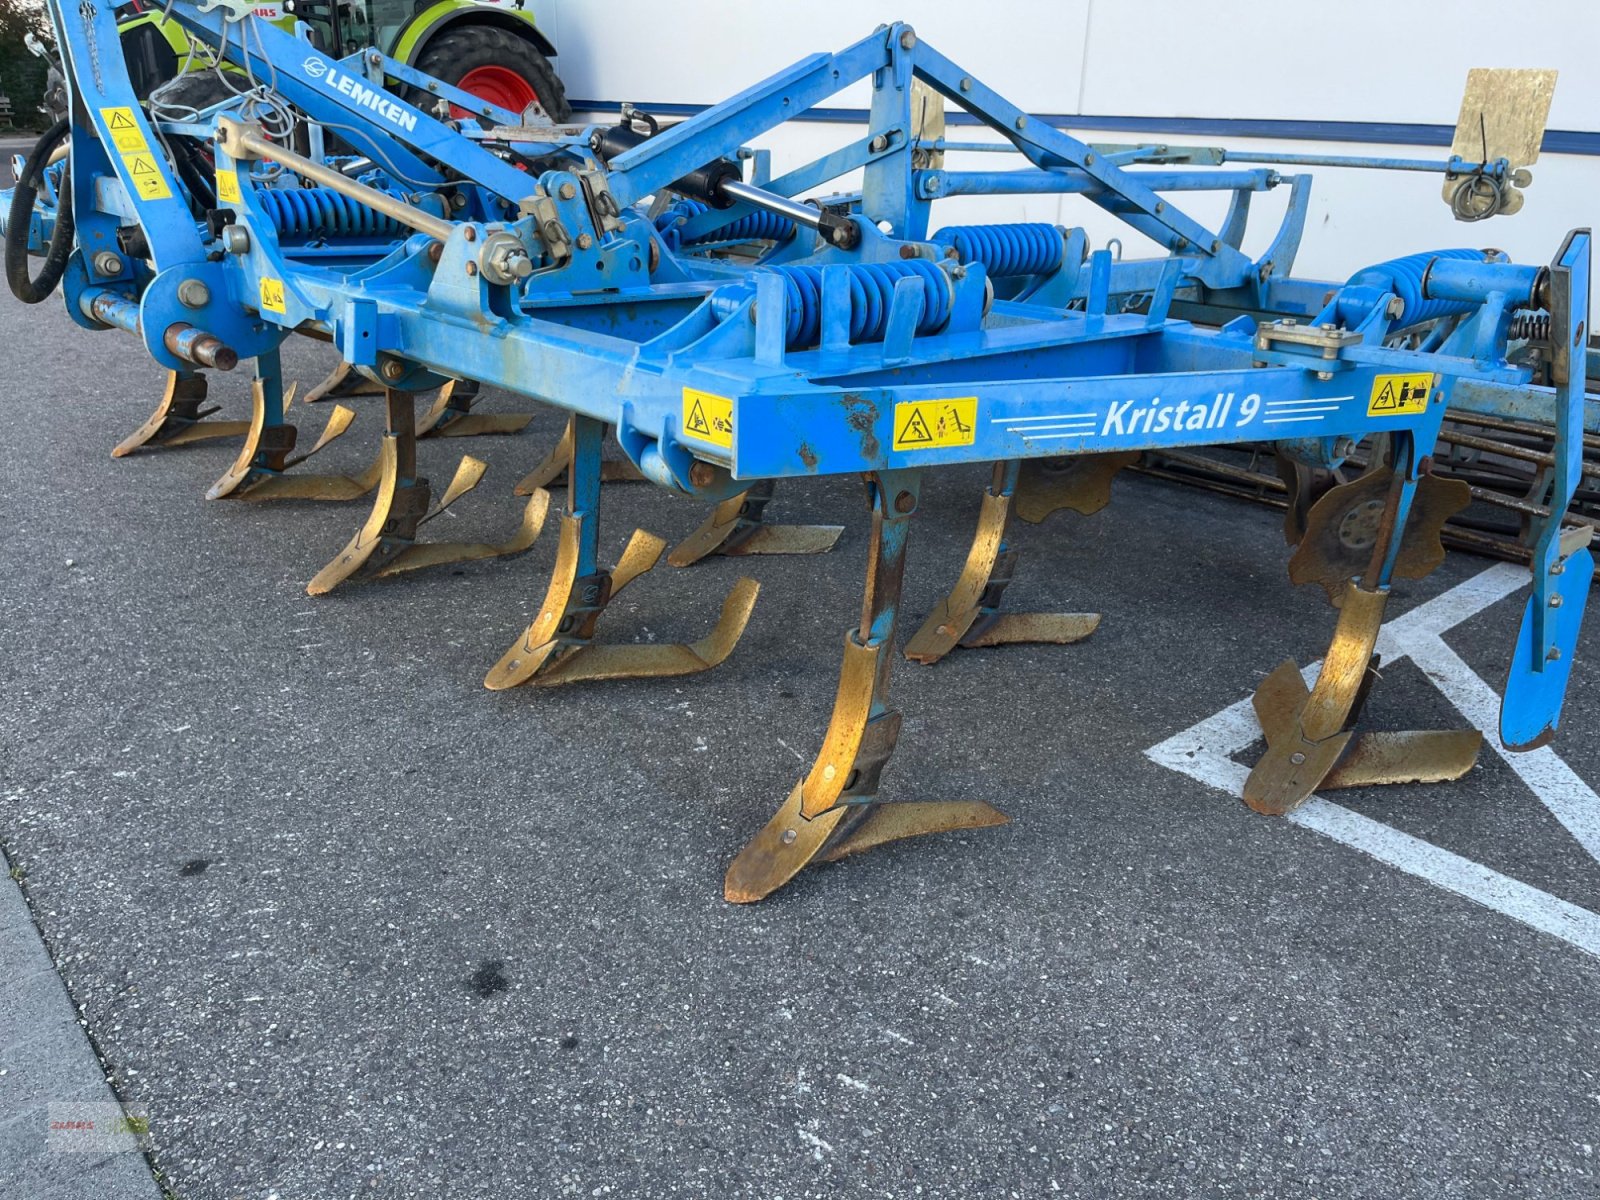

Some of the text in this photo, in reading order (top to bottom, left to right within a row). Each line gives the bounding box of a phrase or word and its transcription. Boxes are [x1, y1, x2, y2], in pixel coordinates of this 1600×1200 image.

[325, 68, 418, 133] LEMKEN
[1100, 392, 1261, 437] Kristall 9
